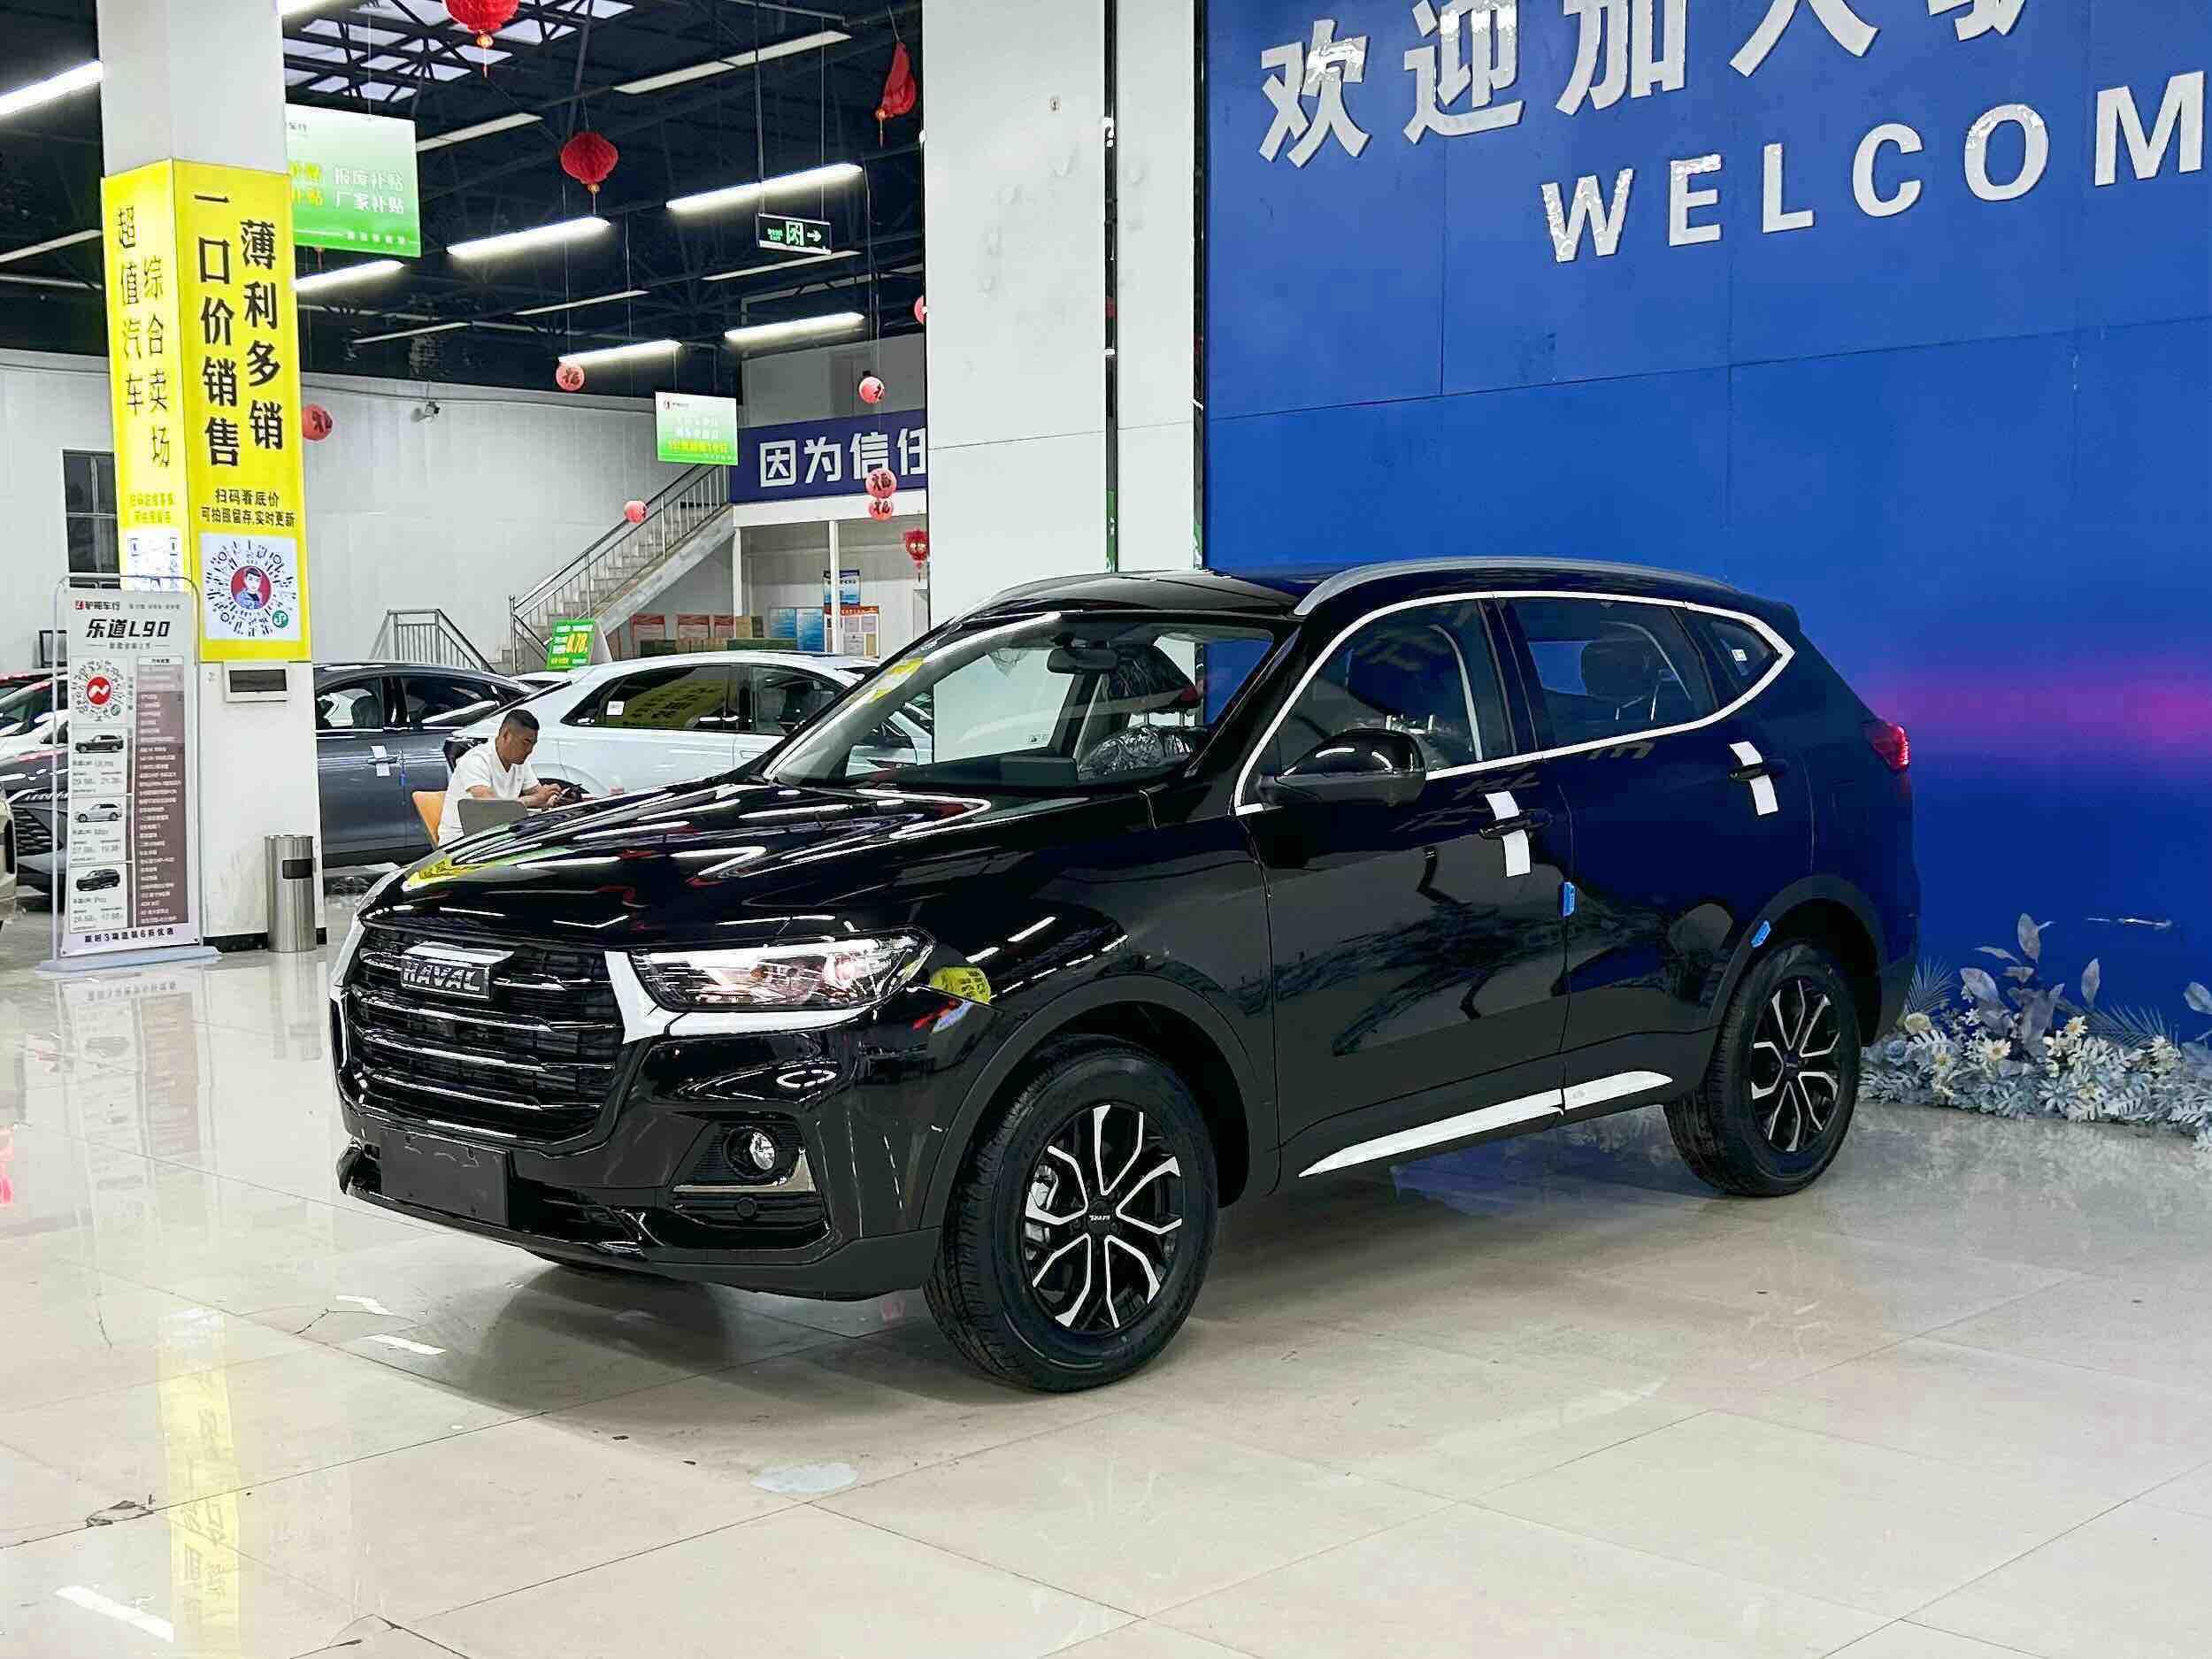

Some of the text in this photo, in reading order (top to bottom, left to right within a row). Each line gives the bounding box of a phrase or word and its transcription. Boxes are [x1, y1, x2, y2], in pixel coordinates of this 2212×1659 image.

[1540, 71, 2205, 264] WELCOM
[119, 204, 144, 416] 超值汽车
[143, 254, 170, 468] 综合卖场
[194, 194, 240, 467] 一口价销售
[240, 219, 284, 450] 薄利多销
[86, 618, 171, 638] 乐道L90
[403, 960, 481, 992] HAVAL
